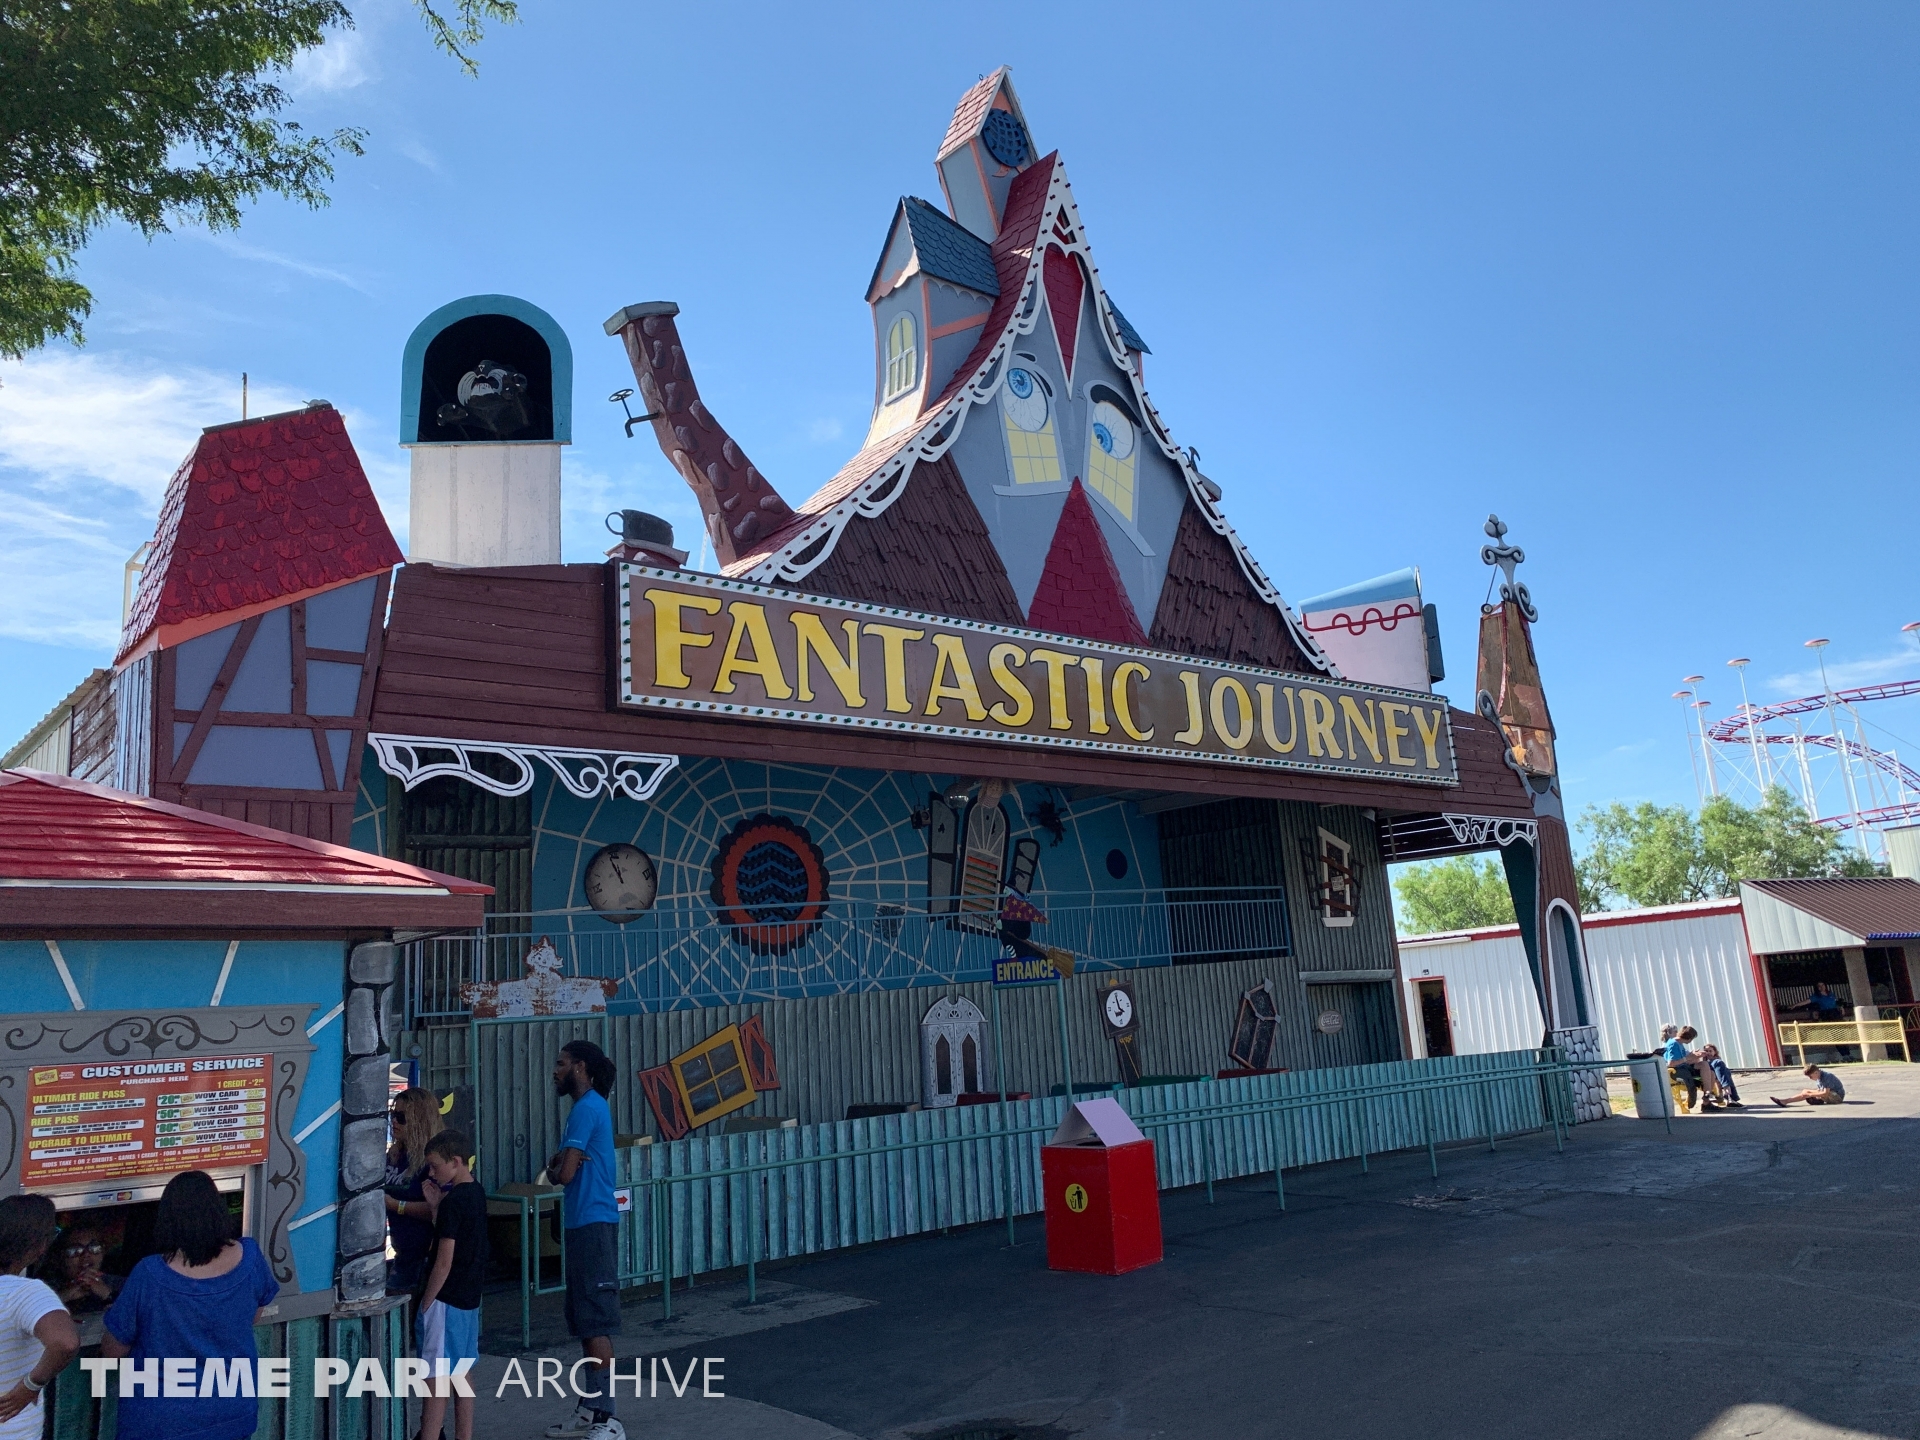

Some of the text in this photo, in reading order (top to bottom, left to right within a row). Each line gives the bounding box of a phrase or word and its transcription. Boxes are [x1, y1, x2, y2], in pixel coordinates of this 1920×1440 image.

[643, 588, 1443, 770] FANTASTIC JOURNEY
[996, 959, 1055, 981] ENTRANCE
[81, 1062, 186, 1079] CUSTOMER
[192, 1058, 264, 1072] SERVICE
[120, 1076, 166, 1085] PURCHASE
[223, 1079, 247, 1088] CREDIT
[32, 1089, 126, 1104] ULTIMATE RIDE PASS
[218, 1090, 239, 1098] CARD
[193, 1105, 216, 1113] WOW
[31, 1117, 52, 1126] RIDE
[54, 1115, 79, 1124] PASS
[193, 1119, 215, 1127] WOW
[28, 1137, 72, 1149] UPGRADE
[75, 1136, 86, 1145] TO
[89, 1132, 132, 1144] ULTIMATE
